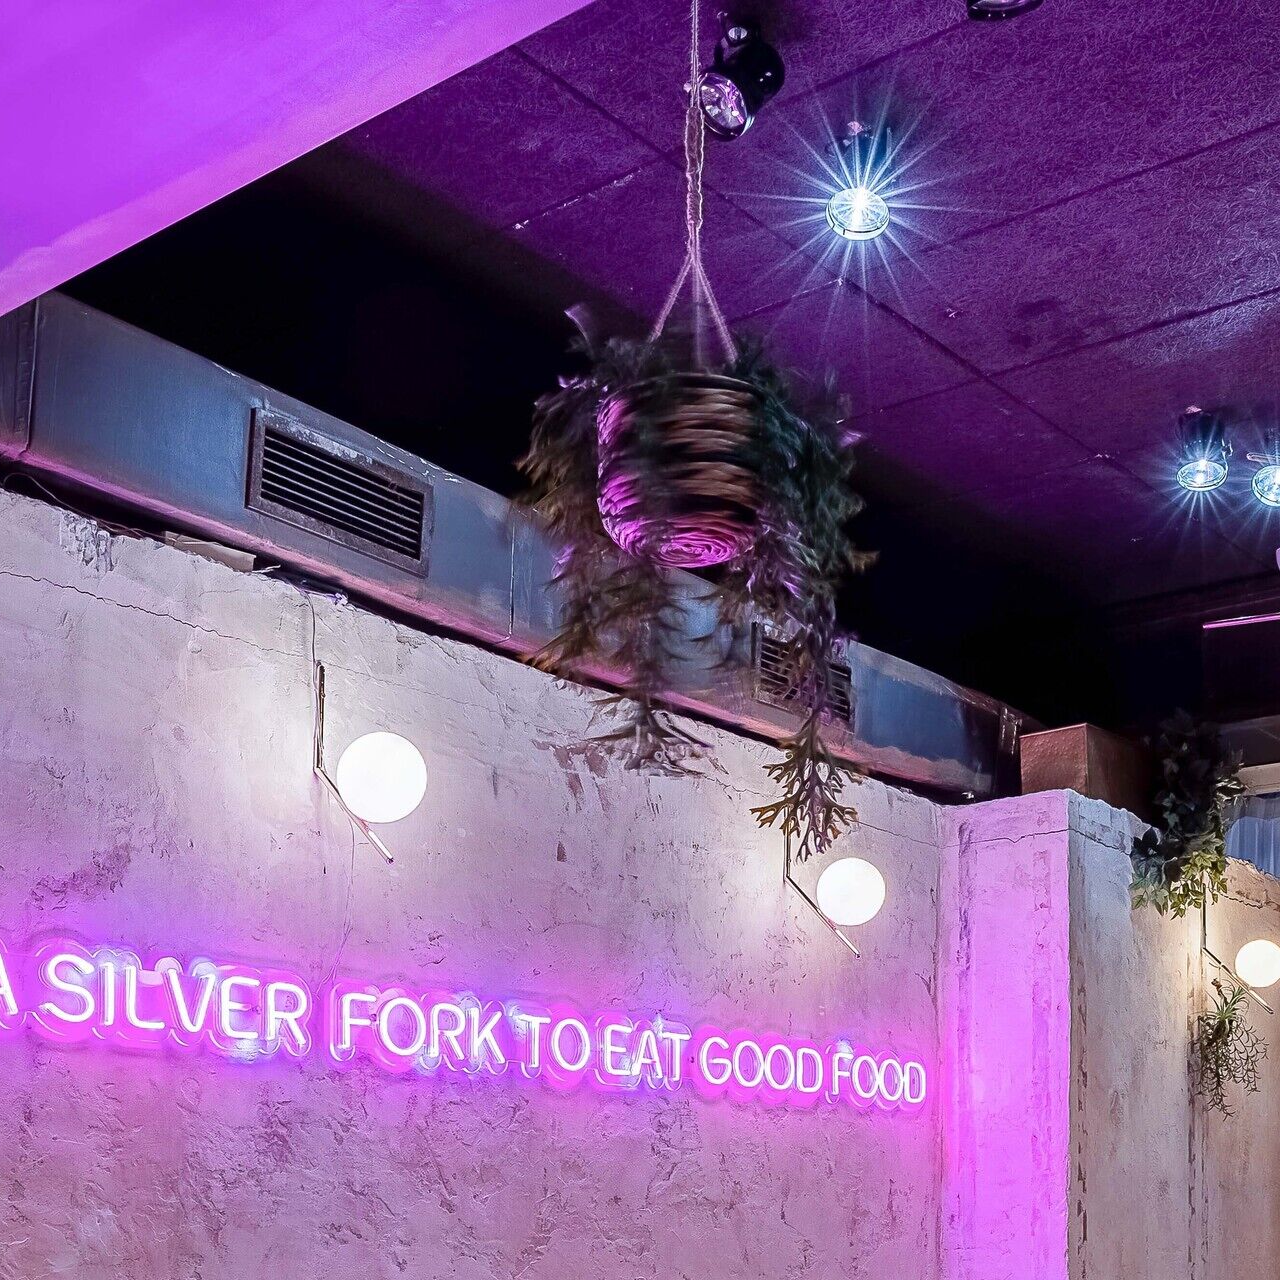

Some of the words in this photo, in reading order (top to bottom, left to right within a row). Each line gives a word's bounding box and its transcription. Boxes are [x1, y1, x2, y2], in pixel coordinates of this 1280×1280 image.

[44, 952, 308, 1047] SILVER
[338, 992, 506, 1065] FORK
[520, 1016, 589, 1071] TO
[601, 1023, 692, 1081] EAT
[700, 1039, 823, 1094] GOOD
[831, 1053, 927, 1104] FOOD
